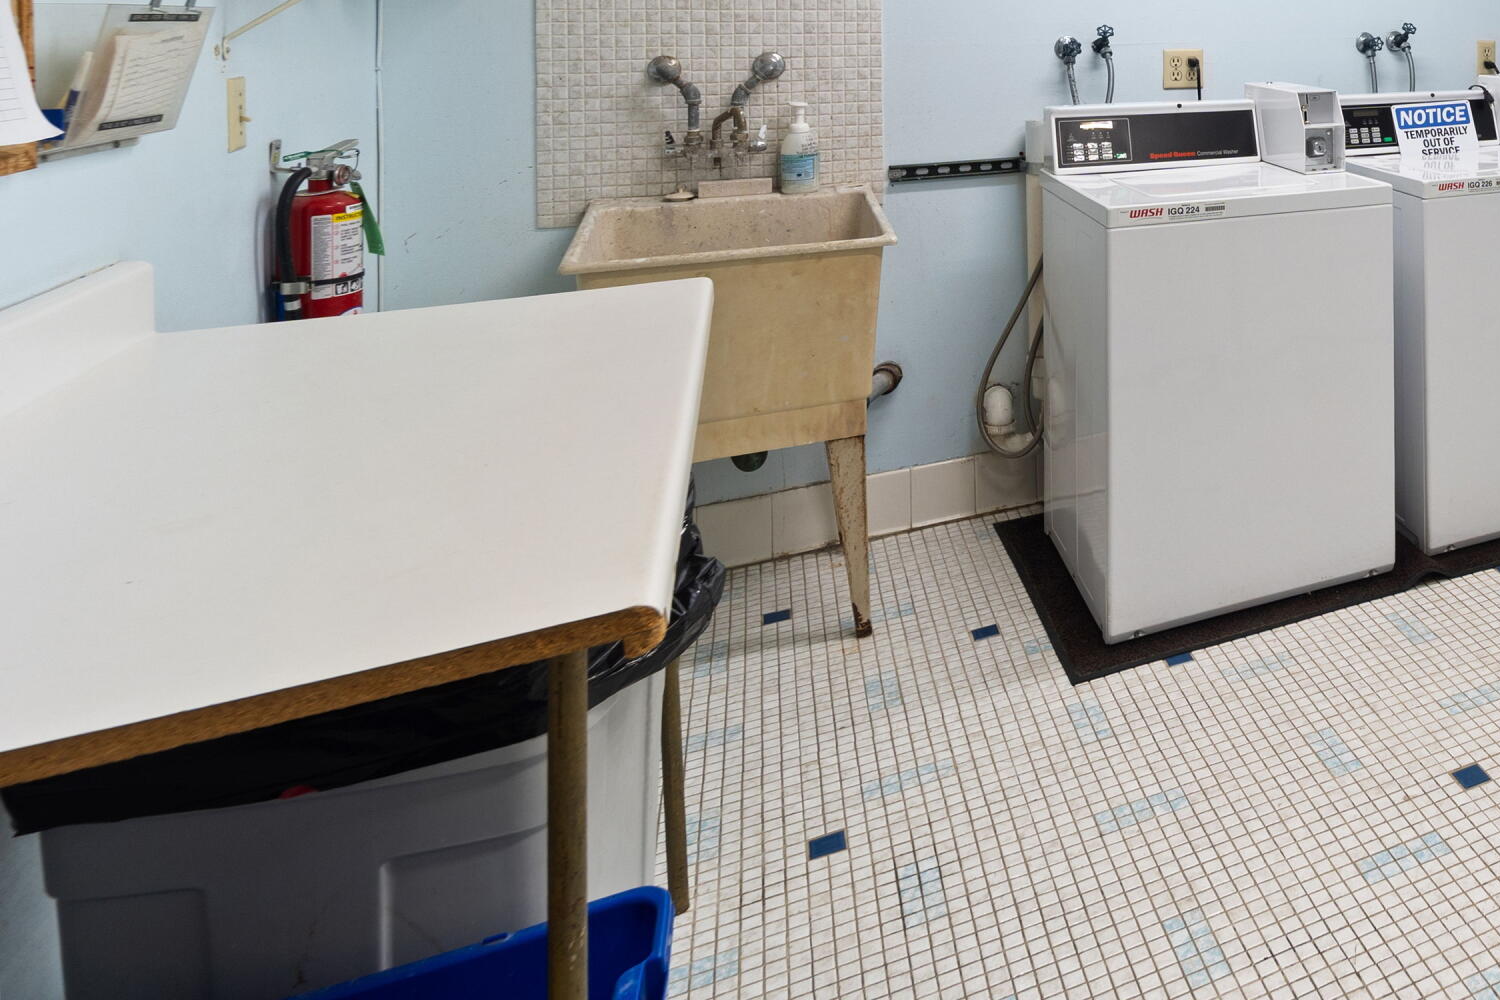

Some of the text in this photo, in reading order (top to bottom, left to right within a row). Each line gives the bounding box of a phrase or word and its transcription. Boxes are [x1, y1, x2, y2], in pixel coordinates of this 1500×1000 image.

[1400, 106, 1466, 126] NOTICE
[1404, 126, 1468, 139] TEMPORARILY
[1423, 136, 1455, 148] OUT OF
[1438, 181, 1465, 191] WASH
[1129, 206, 1200, 219] WASH IGQ 224
